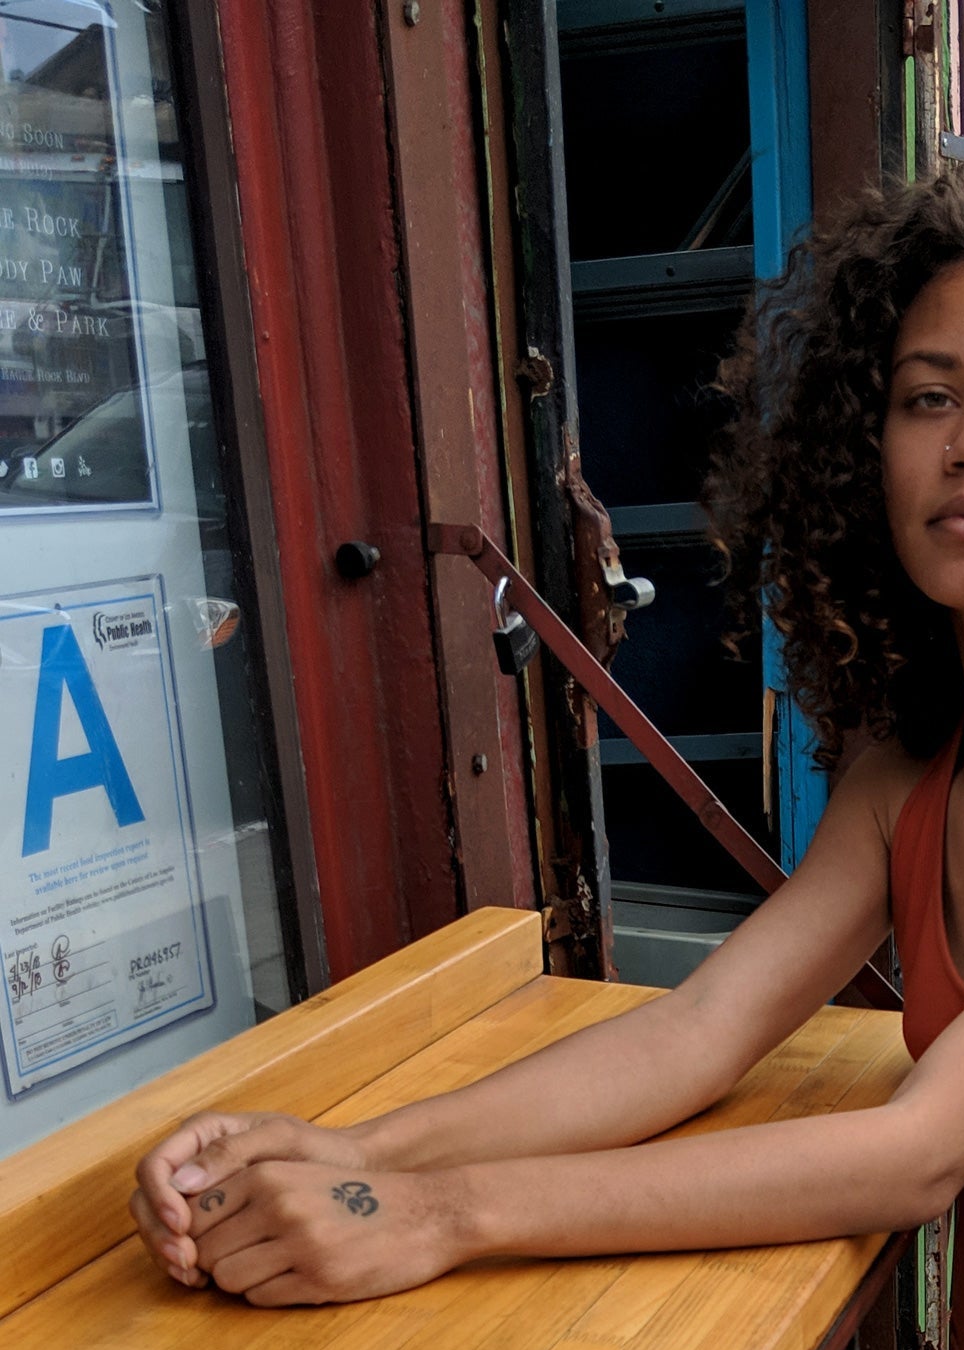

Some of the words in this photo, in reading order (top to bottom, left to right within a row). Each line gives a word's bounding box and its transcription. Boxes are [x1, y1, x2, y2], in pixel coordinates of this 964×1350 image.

[0, 208, 14, 229] E
[25, 207, 82, 239] ROCK
[0, 257, 28, 282] DY
[40, 259, 82, 287] PAW
[28, 307, 44, 332] &
[55, 310, 111, 337] PARK
[107, 622, 130, 642] Public
[130, 618, 153, 637] Health
[22, 624, 145, 858] A
